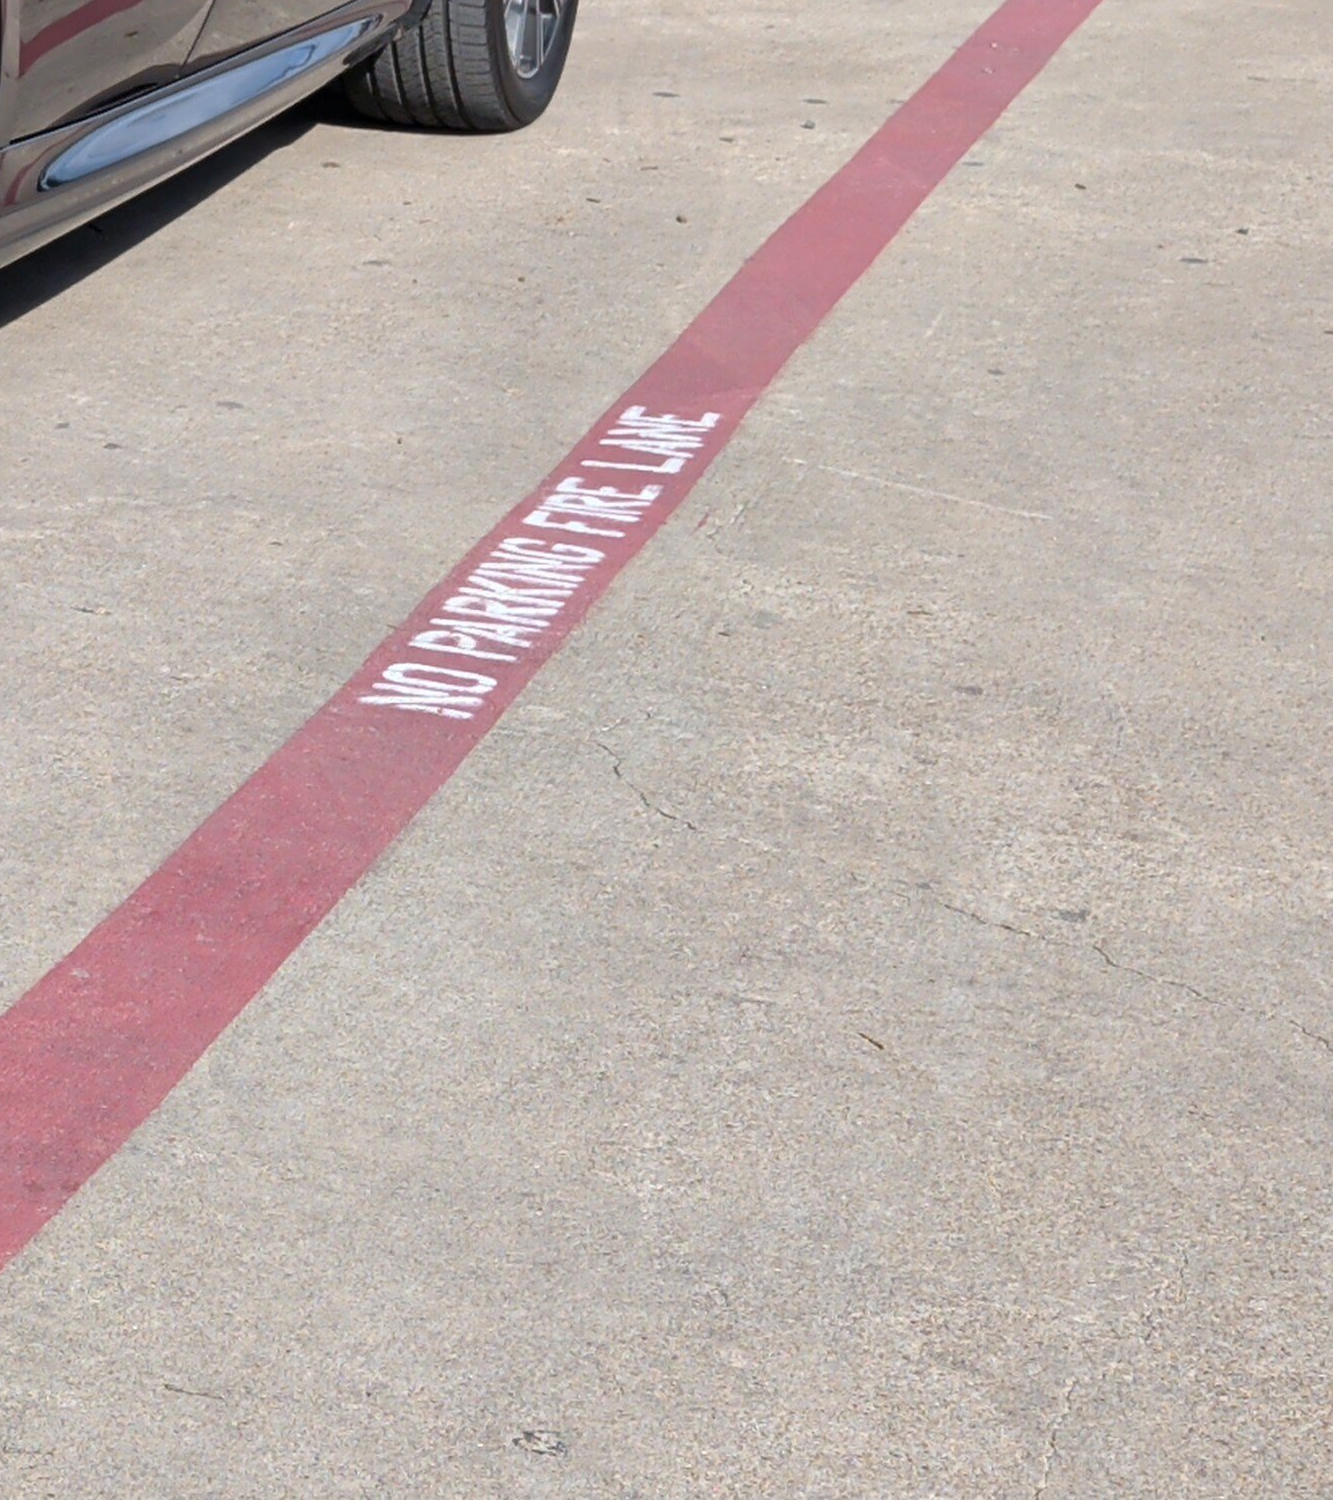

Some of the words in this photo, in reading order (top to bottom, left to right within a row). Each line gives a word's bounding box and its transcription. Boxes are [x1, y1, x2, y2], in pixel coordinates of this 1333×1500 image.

[580, 404, 723, 474] LANE
[522, 476, 665, 538] FIRE
[408, 536, 606, 663] PARKING
[358, 661, 498, 720] NO
